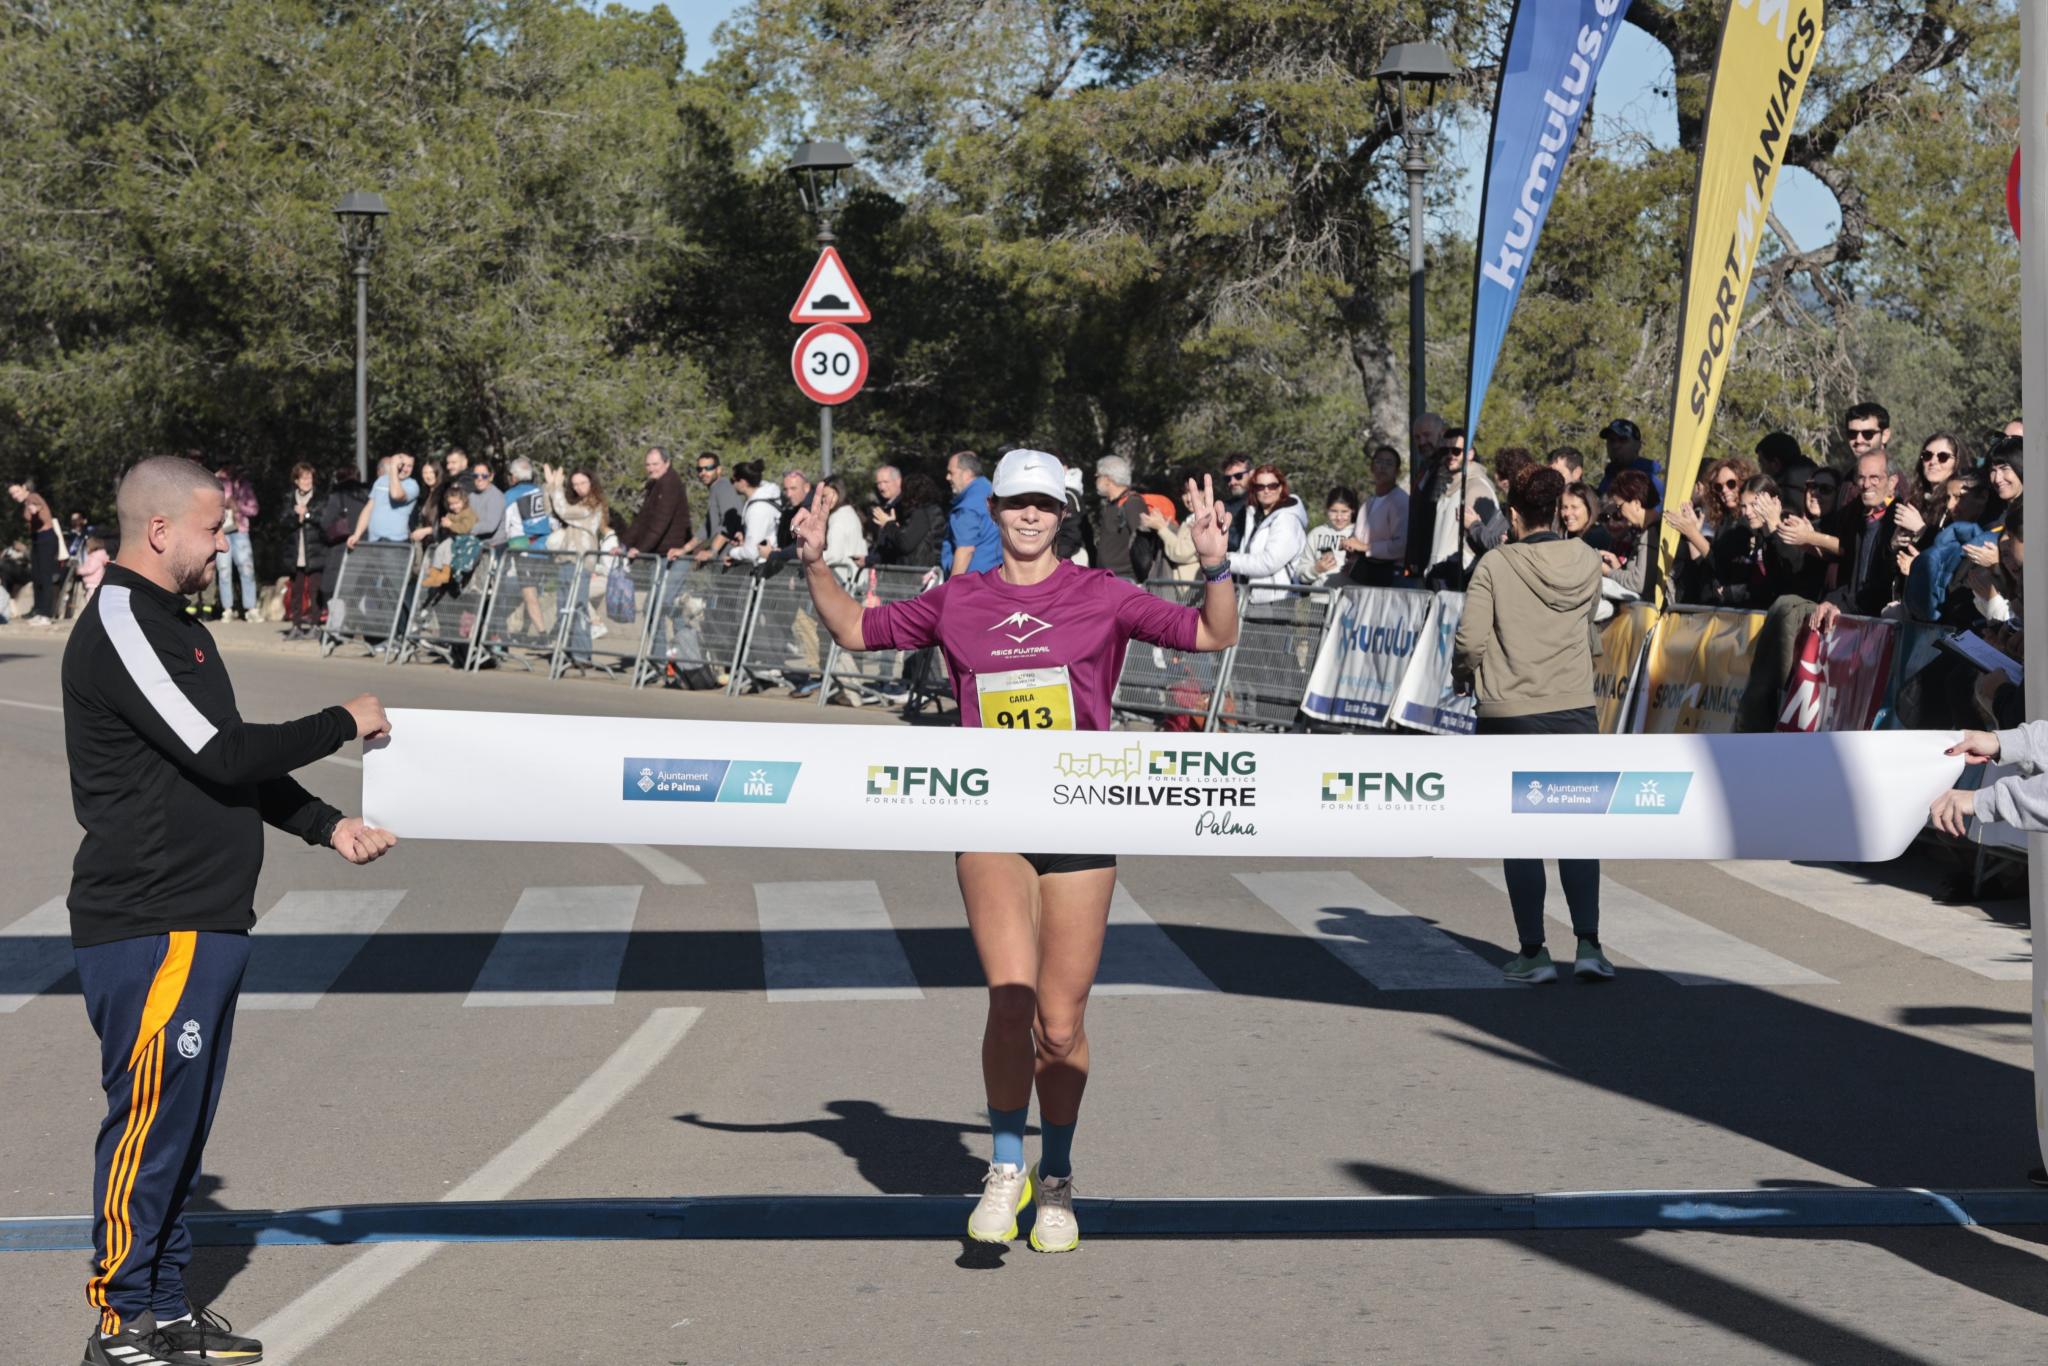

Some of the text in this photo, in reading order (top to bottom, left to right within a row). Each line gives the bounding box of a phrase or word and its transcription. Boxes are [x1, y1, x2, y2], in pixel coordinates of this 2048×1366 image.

[1691, 7, 1816, 424] SPORTMANIACS
[811, 351, 850, 377] 30
[1013, 646, 1050, 655] FUJITRAIL
[1009, 693, 1035, 704] CARLA
[996, 706, 1054, 729] 913
[1180, 750, 1257, 776] FNG
[657, 770, 709, 781] Ajuntament
[902, 766, 990, 797] FNG
[657, 782, 701, 792] de Palma
[743, 782, 773, 796] IME
[1358, 771, 1445, 802] FNG
[1547, 783, 1600, 794] Ajuntament
[865, 797, 989, 806] FORNES LOGISTICS
[1053, 784, 1257, 807] SANSILVESTRE
[1546, 795, 1591, 804] de Palma
[1635, 794, 1666, 807] IME
[1194, 810, 1258, 836] Palma
